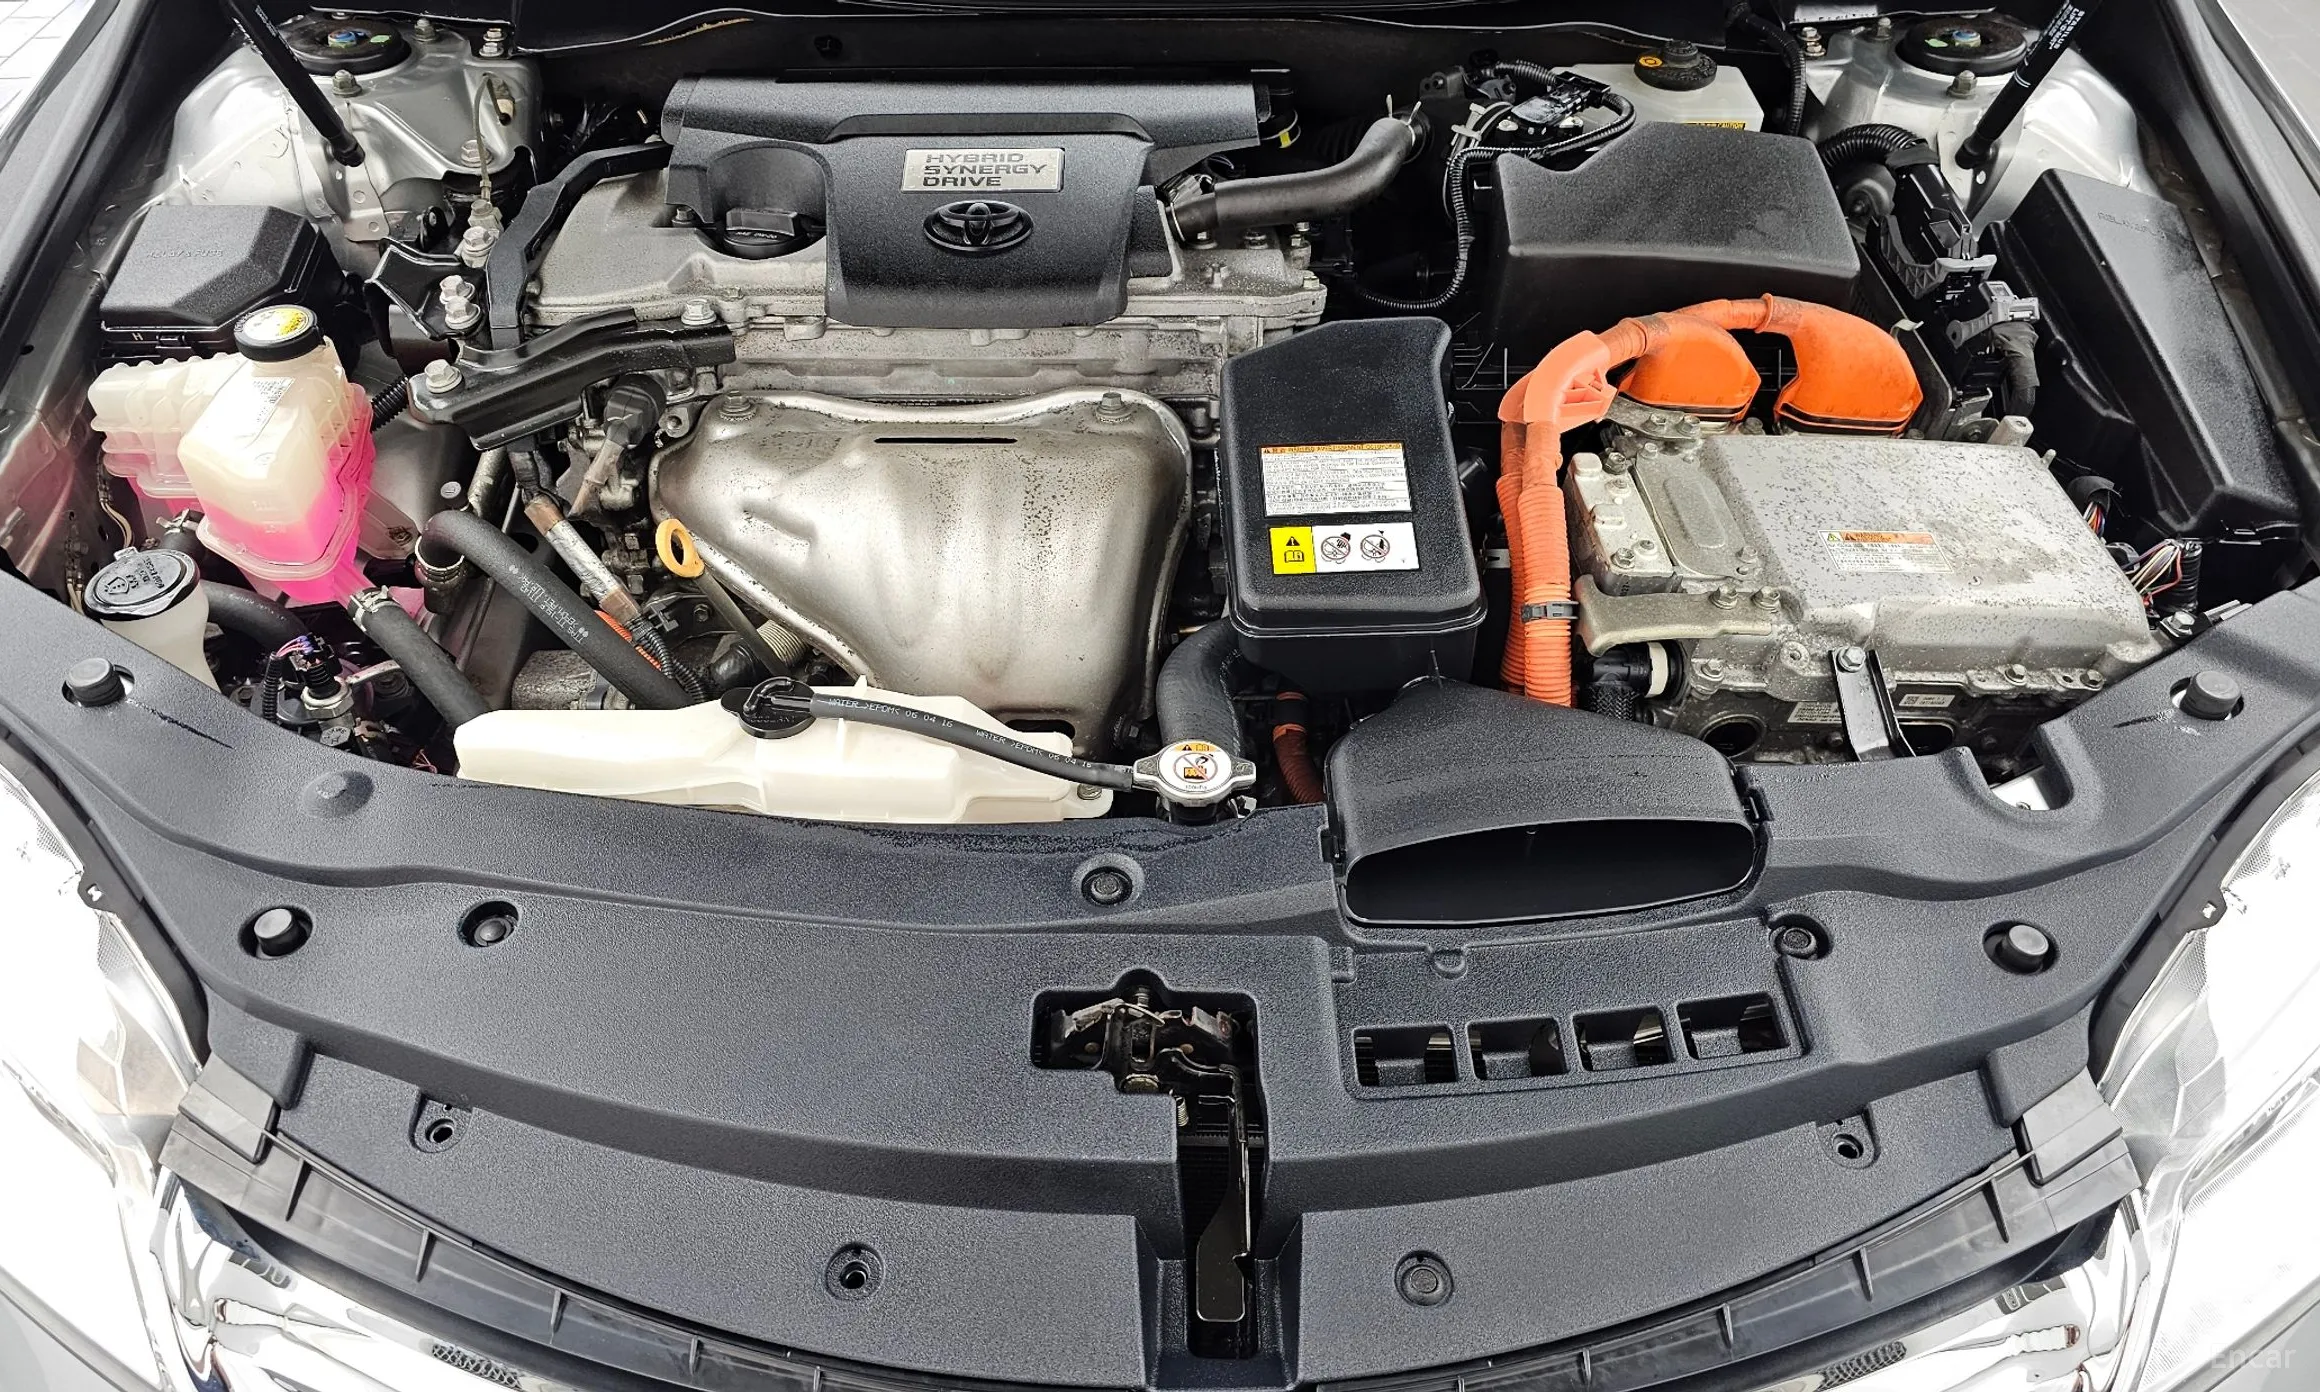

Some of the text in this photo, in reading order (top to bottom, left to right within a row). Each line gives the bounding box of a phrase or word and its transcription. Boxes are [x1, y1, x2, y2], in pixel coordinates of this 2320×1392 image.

[926, 153, 1024, 163] HYBRID
[924, 164, 1047, 175] SYNERGY
[922, 176, 1002, 187] DRIVE
[828, 698, 859, 709] WATER
[976, 729, 1006, 744] WATER
